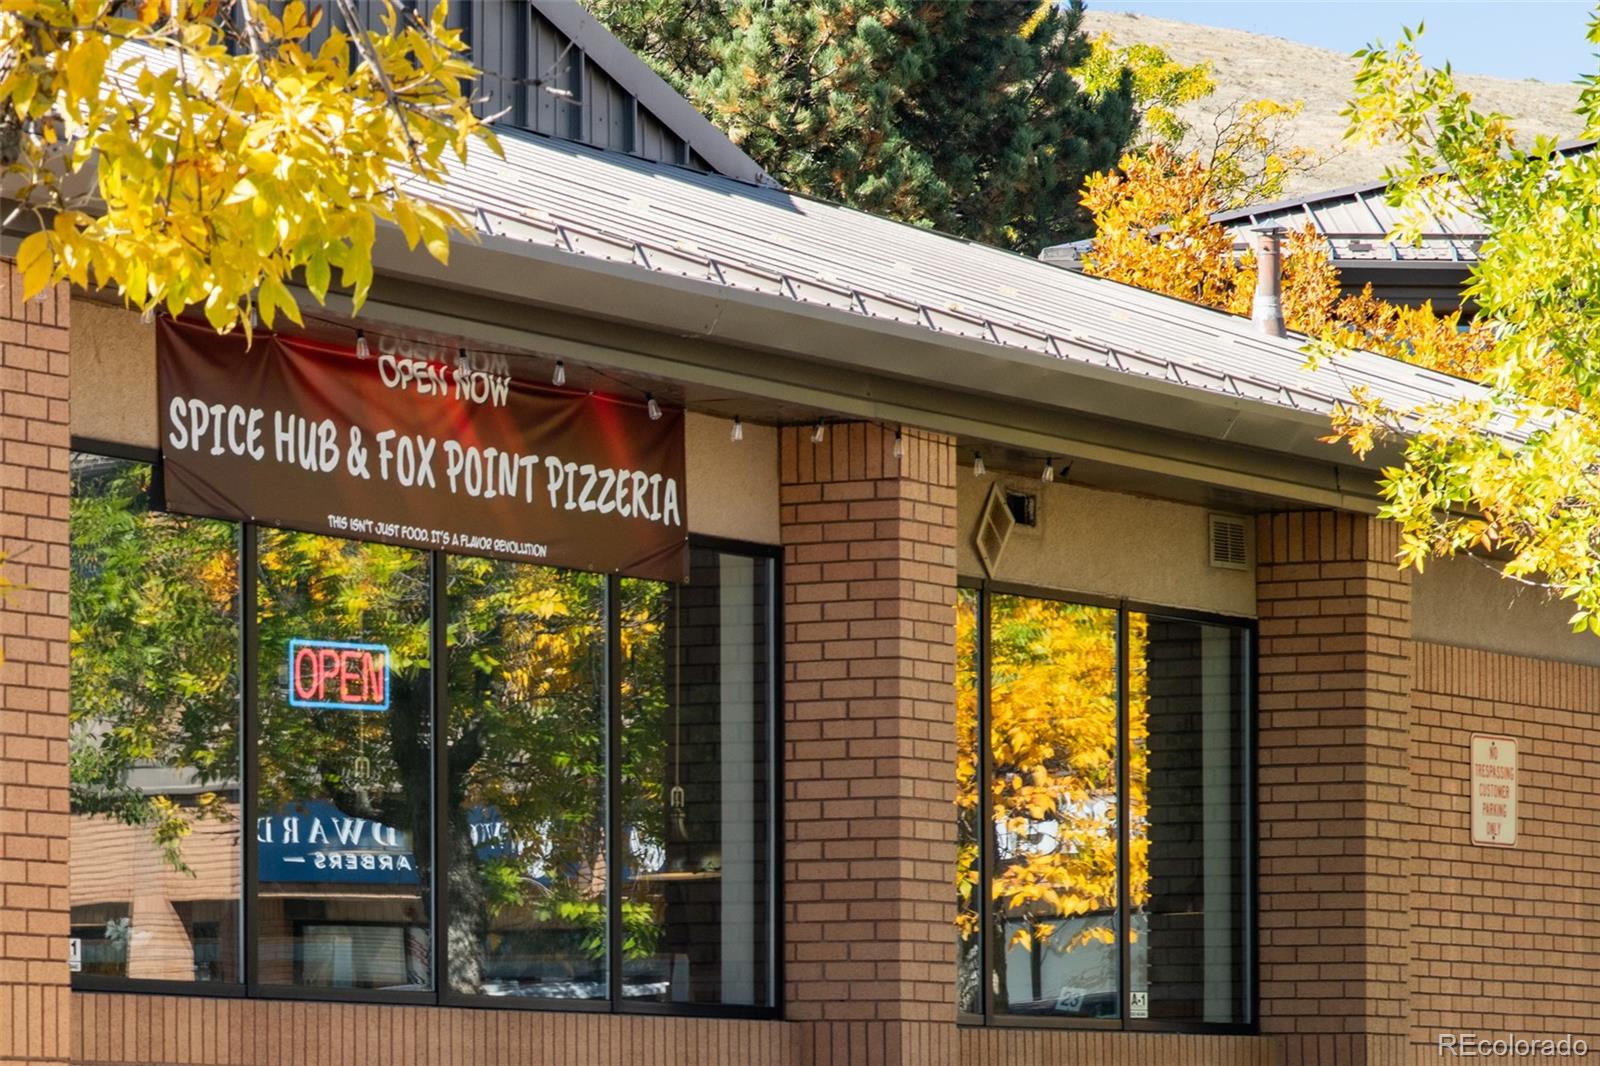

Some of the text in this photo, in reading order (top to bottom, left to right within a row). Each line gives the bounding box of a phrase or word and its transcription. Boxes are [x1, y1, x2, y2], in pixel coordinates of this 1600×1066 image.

[378, 355, 448, 396] OPEN
[452, 369, 511, 407] NOW
[169, 396, 681, 526] SPICE HUB & FOX POINT PIZZERIA
[327, 514, 348, 530] THIS
[350, 518, 374, 534] ISN'T
[375, 522, 400, 537] JUST
[431, 529, 450, 545] IT'S
[452, 533, 459, 546] A
[460, 534, 493, 550] FLAVOR
[493, 538, 548, 557] REVOLUTION
[294, 647, 385, 703] OPEN
